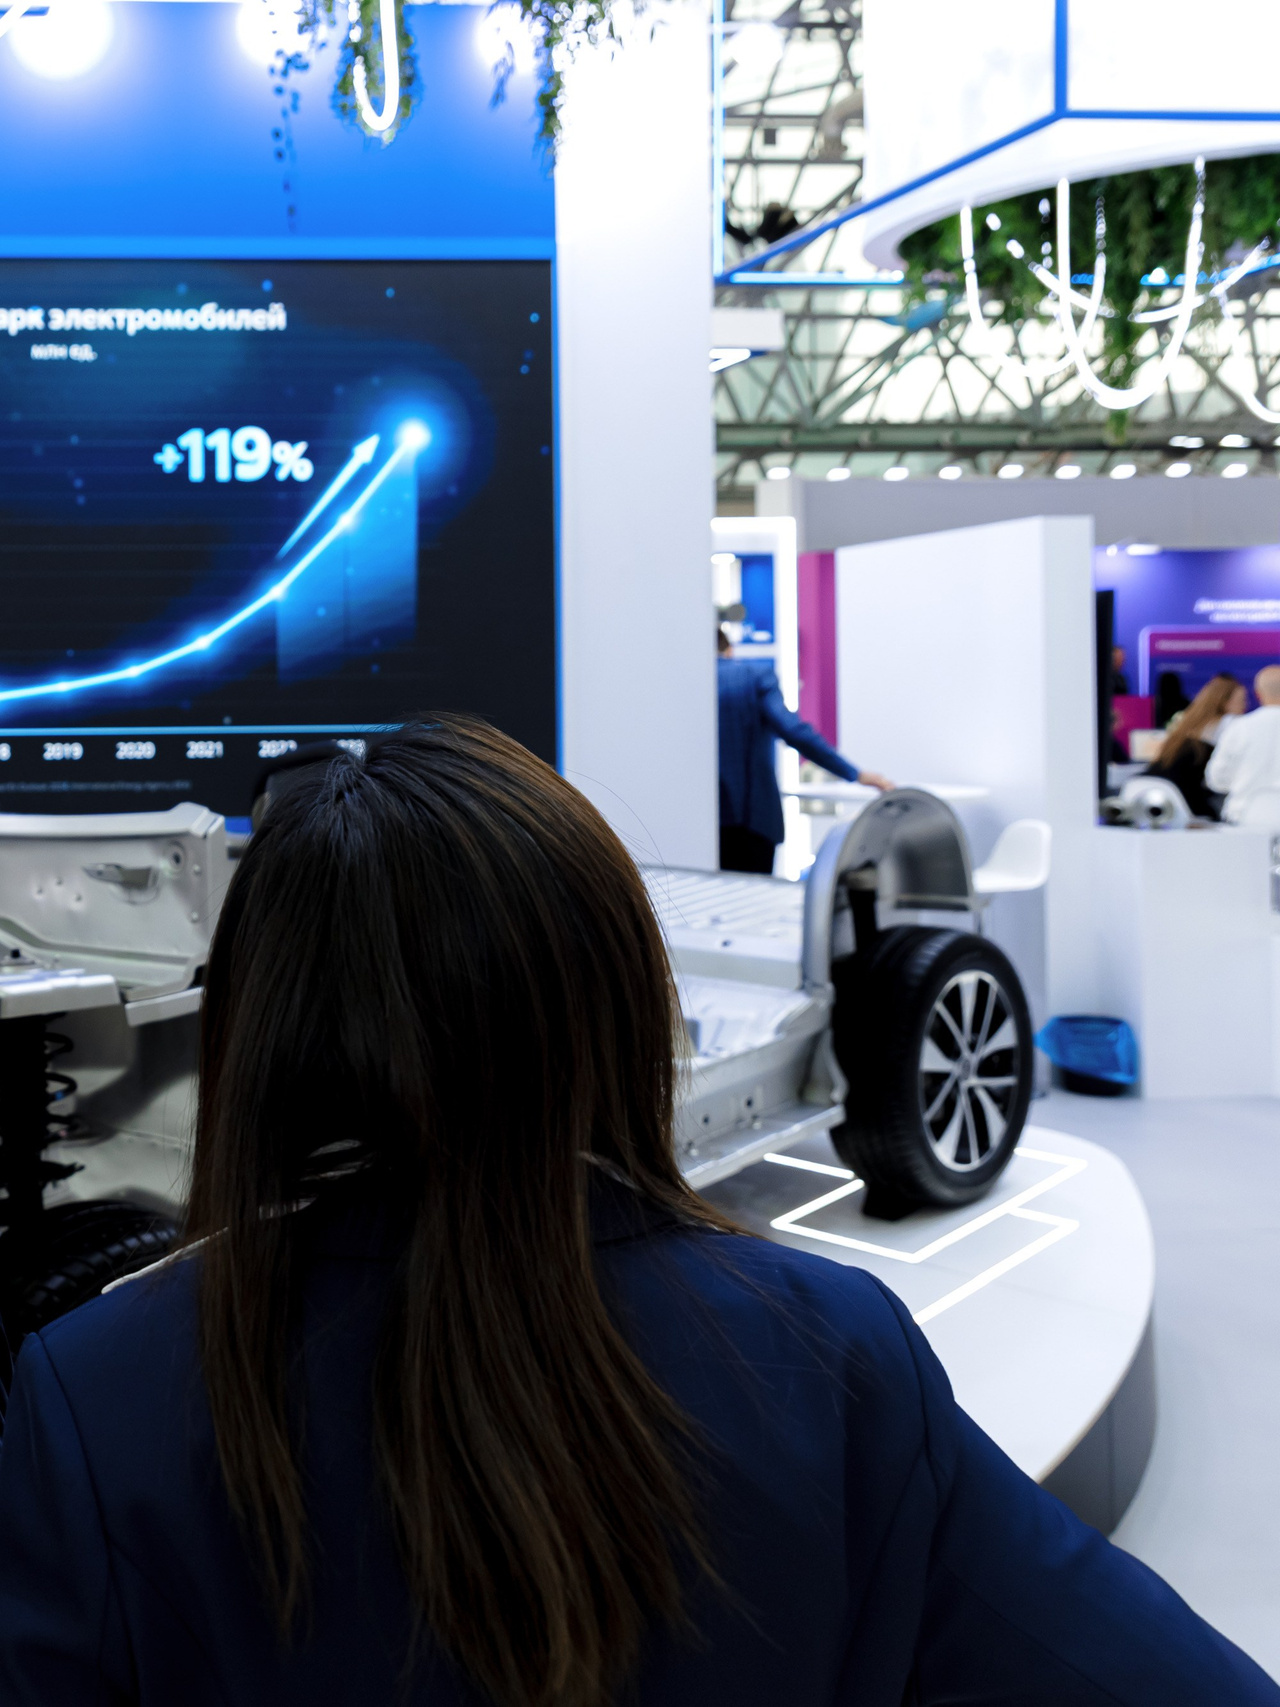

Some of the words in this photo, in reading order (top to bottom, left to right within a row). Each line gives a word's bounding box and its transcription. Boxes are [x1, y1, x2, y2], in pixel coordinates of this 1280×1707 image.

[48, 302, 287, 337] электромобилей
[30, 344, 68, 361] млн
[153, 425, 314, 483] +119%
[43, 742, 84, 761] 2019
[116, 741, 156, 760] 2020
[186, 740, 224, 759] 2021
